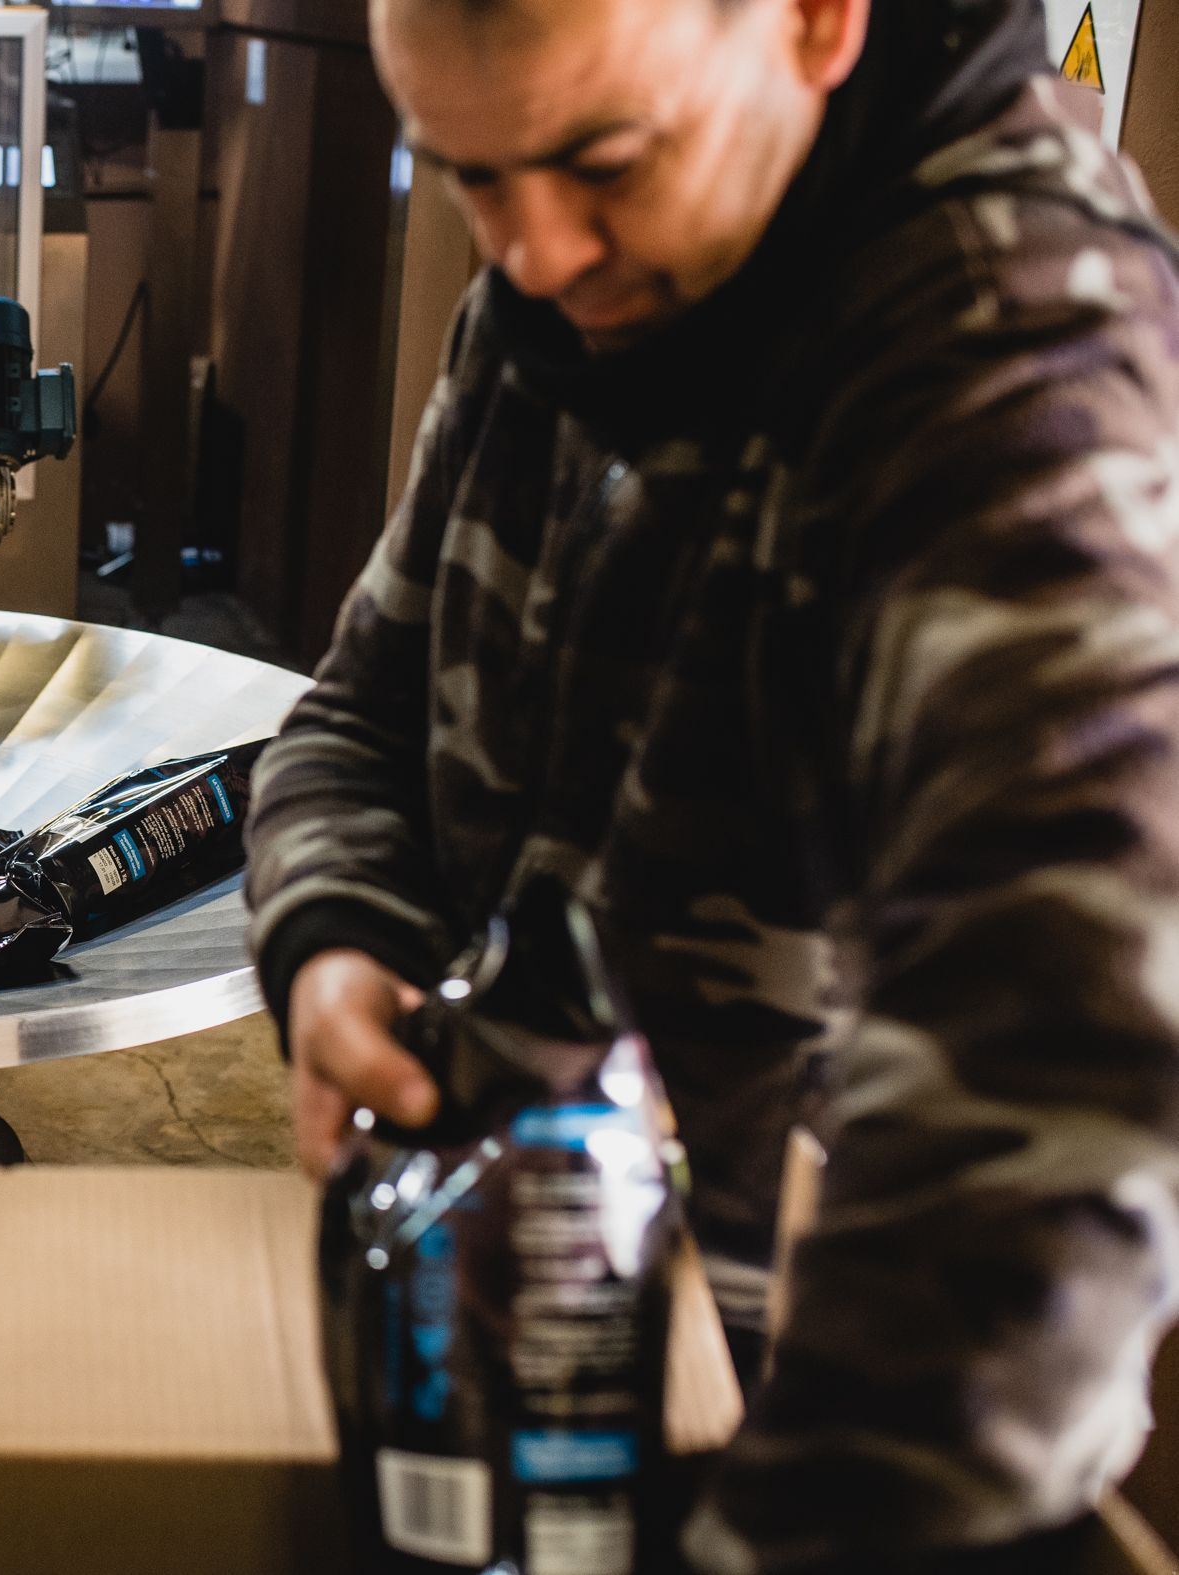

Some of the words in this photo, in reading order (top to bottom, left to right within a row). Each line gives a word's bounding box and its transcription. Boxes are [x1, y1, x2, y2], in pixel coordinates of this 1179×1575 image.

[107, 844, 117, 858] Peso
[114, 856, 123, 869] Neto
[119, 873, 128, 882] Kg
